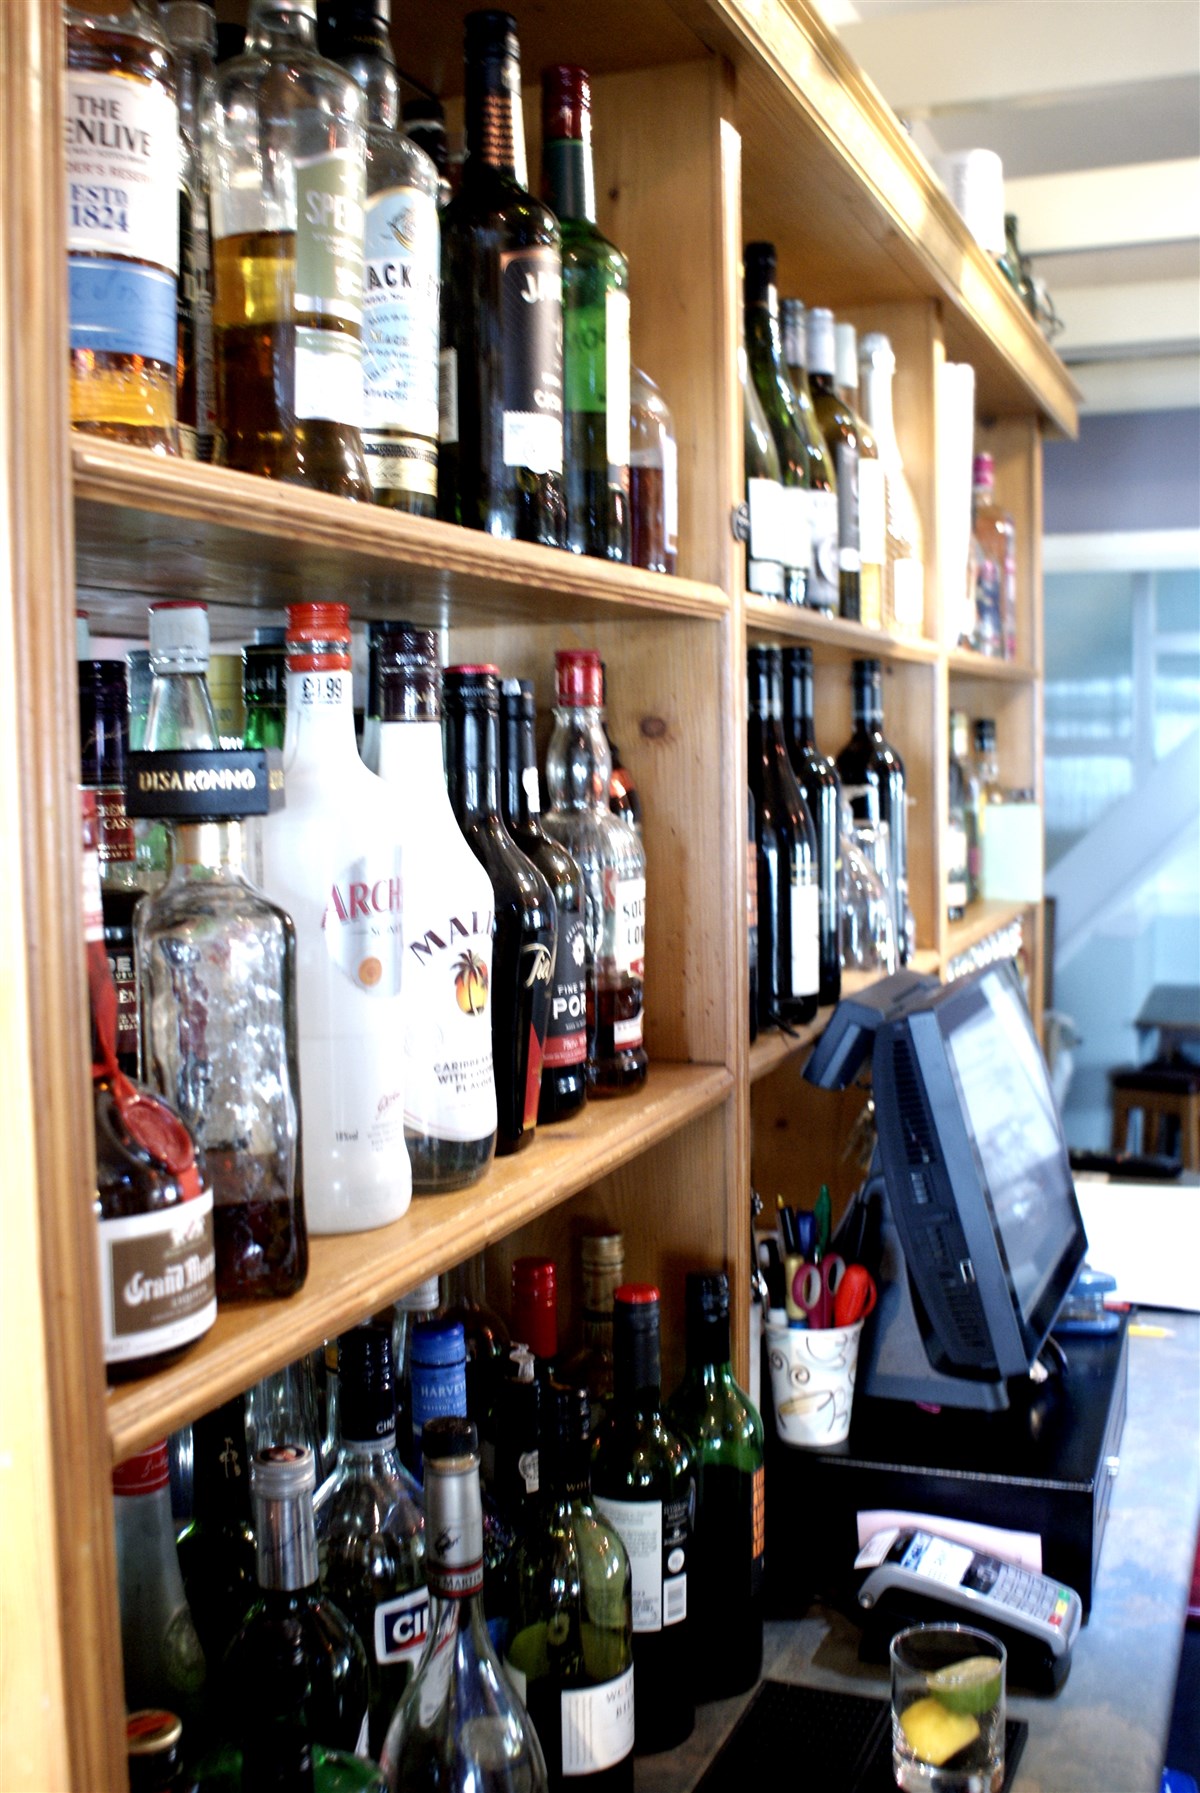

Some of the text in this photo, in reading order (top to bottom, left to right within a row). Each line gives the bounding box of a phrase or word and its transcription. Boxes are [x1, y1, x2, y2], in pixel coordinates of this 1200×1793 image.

[74, 94, 122, 121] THE
[71, 204, 128, 232] 1824
[363, 263, 412, 293] ACK
[138, 768, 257, 792] DISARONNO
[557, 982, 578, 996] FINE
